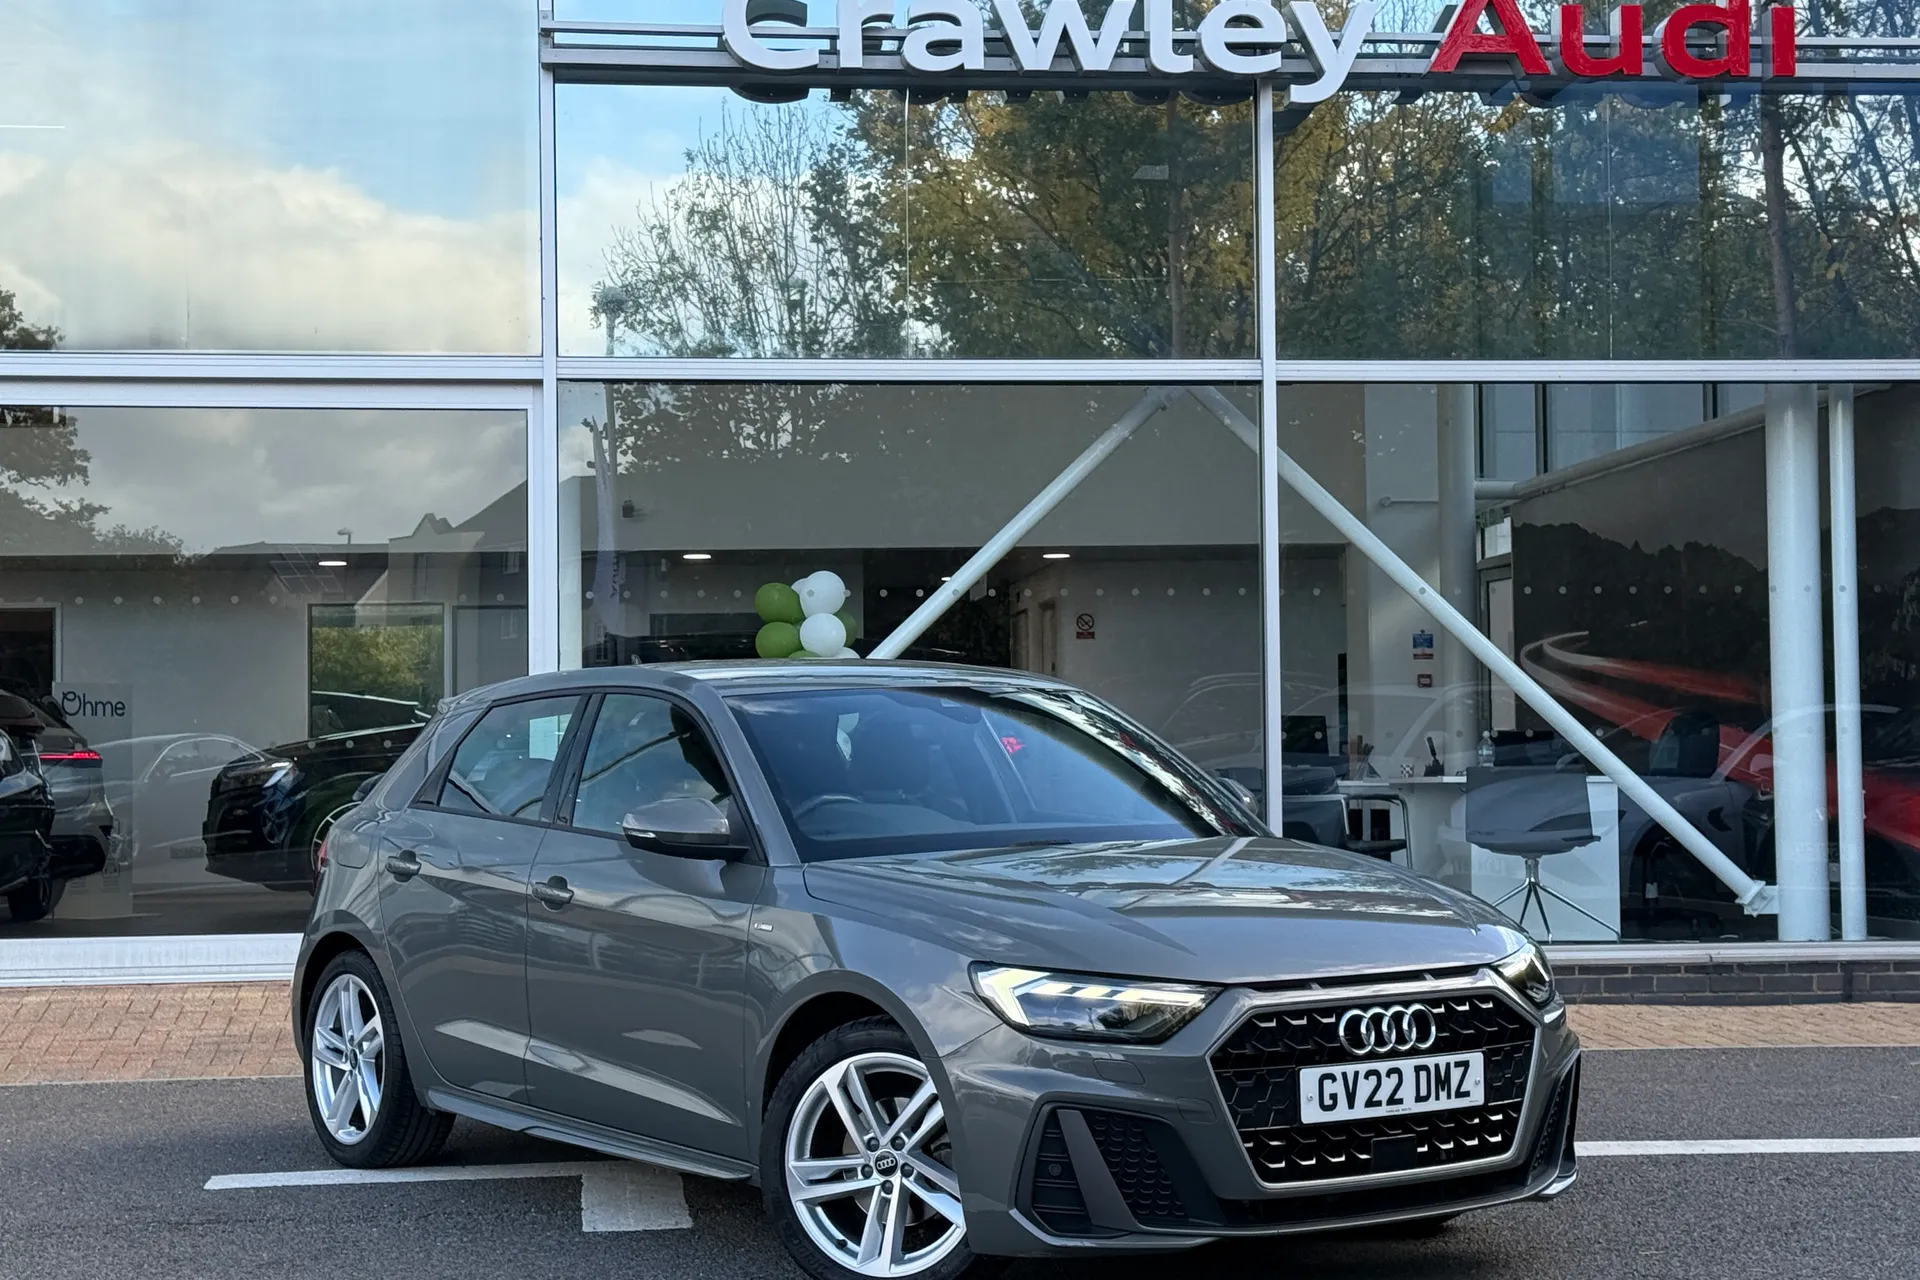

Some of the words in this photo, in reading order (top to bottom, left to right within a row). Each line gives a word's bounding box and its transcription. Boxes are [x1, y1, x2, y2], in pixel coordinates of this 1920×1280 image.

[721, 0, 1374, 103] Crawley
[1428, 0, 1797, 77] Audi
[61, 690, 126, 717] Ohme
[1317, 1066, 1404, 1112] GV22
[1413, 1059, 1471, 1104] DMZ
